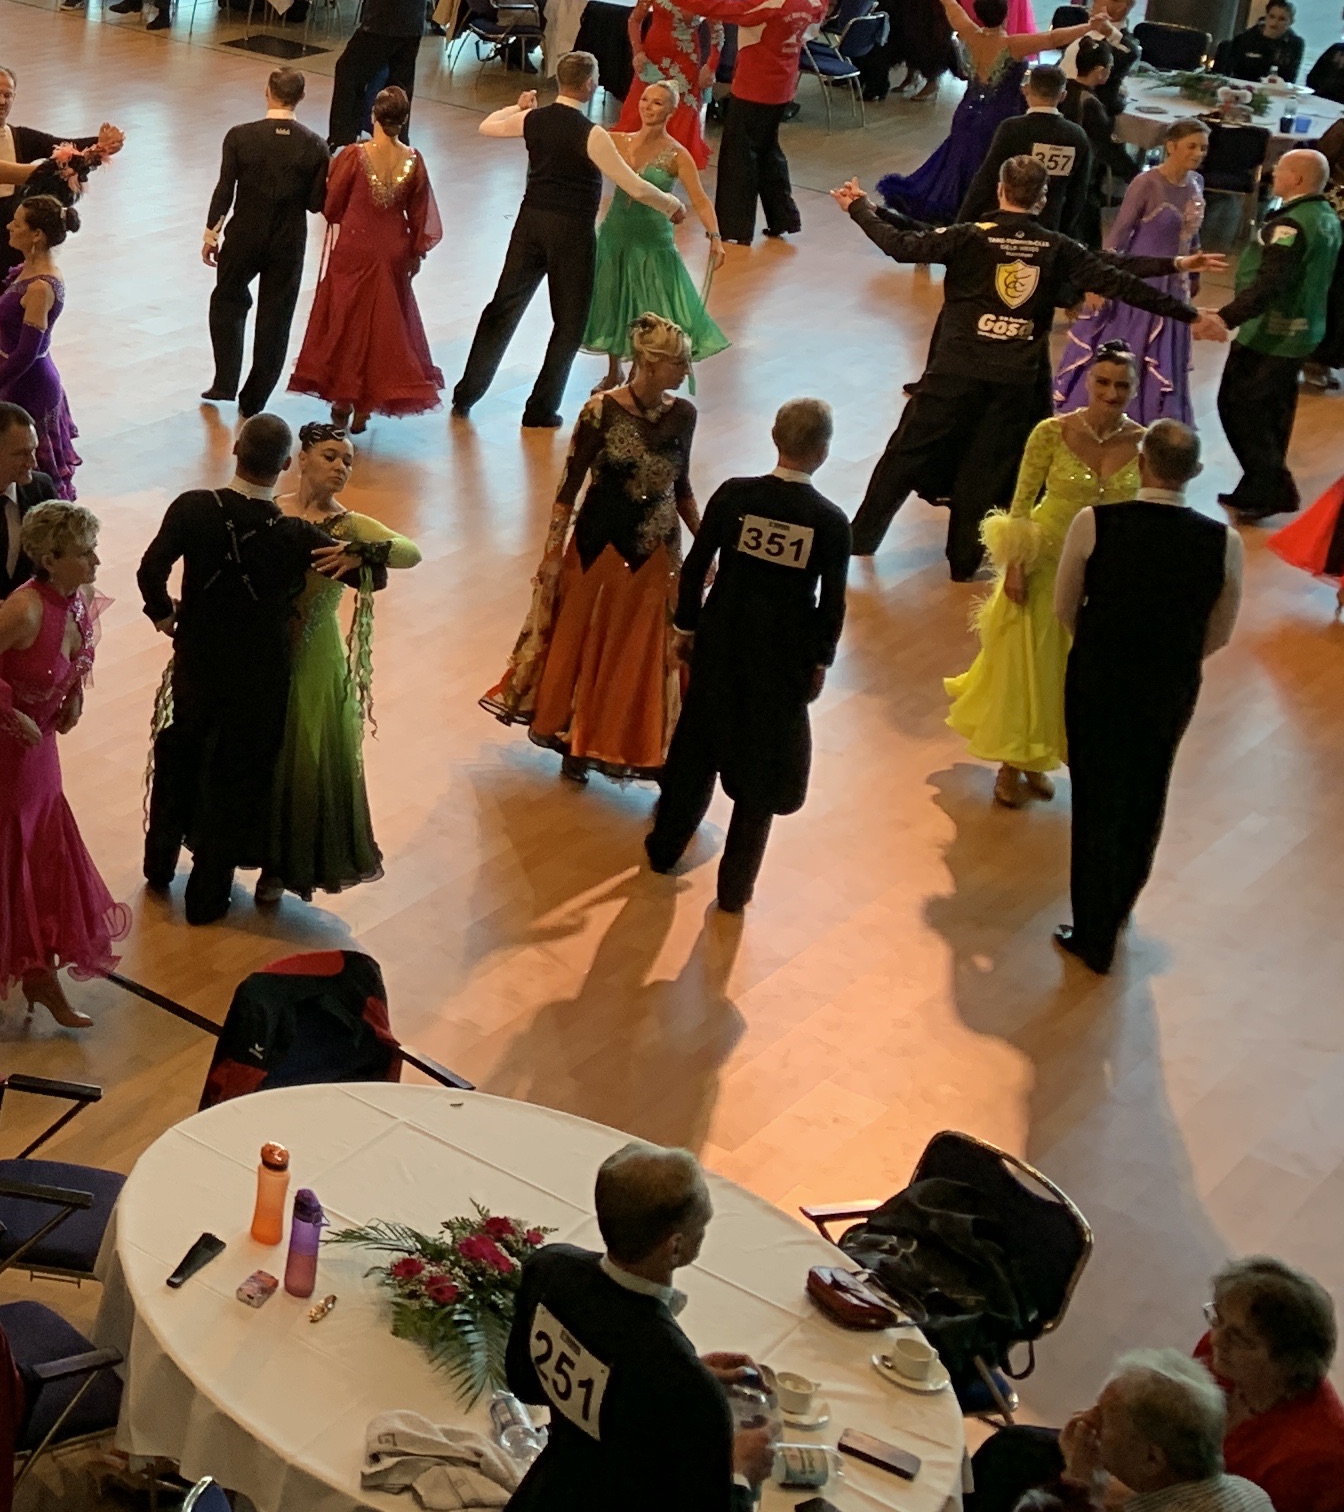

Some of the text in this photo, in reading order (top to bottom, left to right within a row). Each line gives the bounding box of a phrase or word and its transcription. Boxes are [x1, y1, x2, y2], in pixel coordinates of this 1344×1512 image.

[1035, 152, 1072, 171] 357
[743, 527, 804, 562] 351
[534, 1330, 595, 1421] 251
